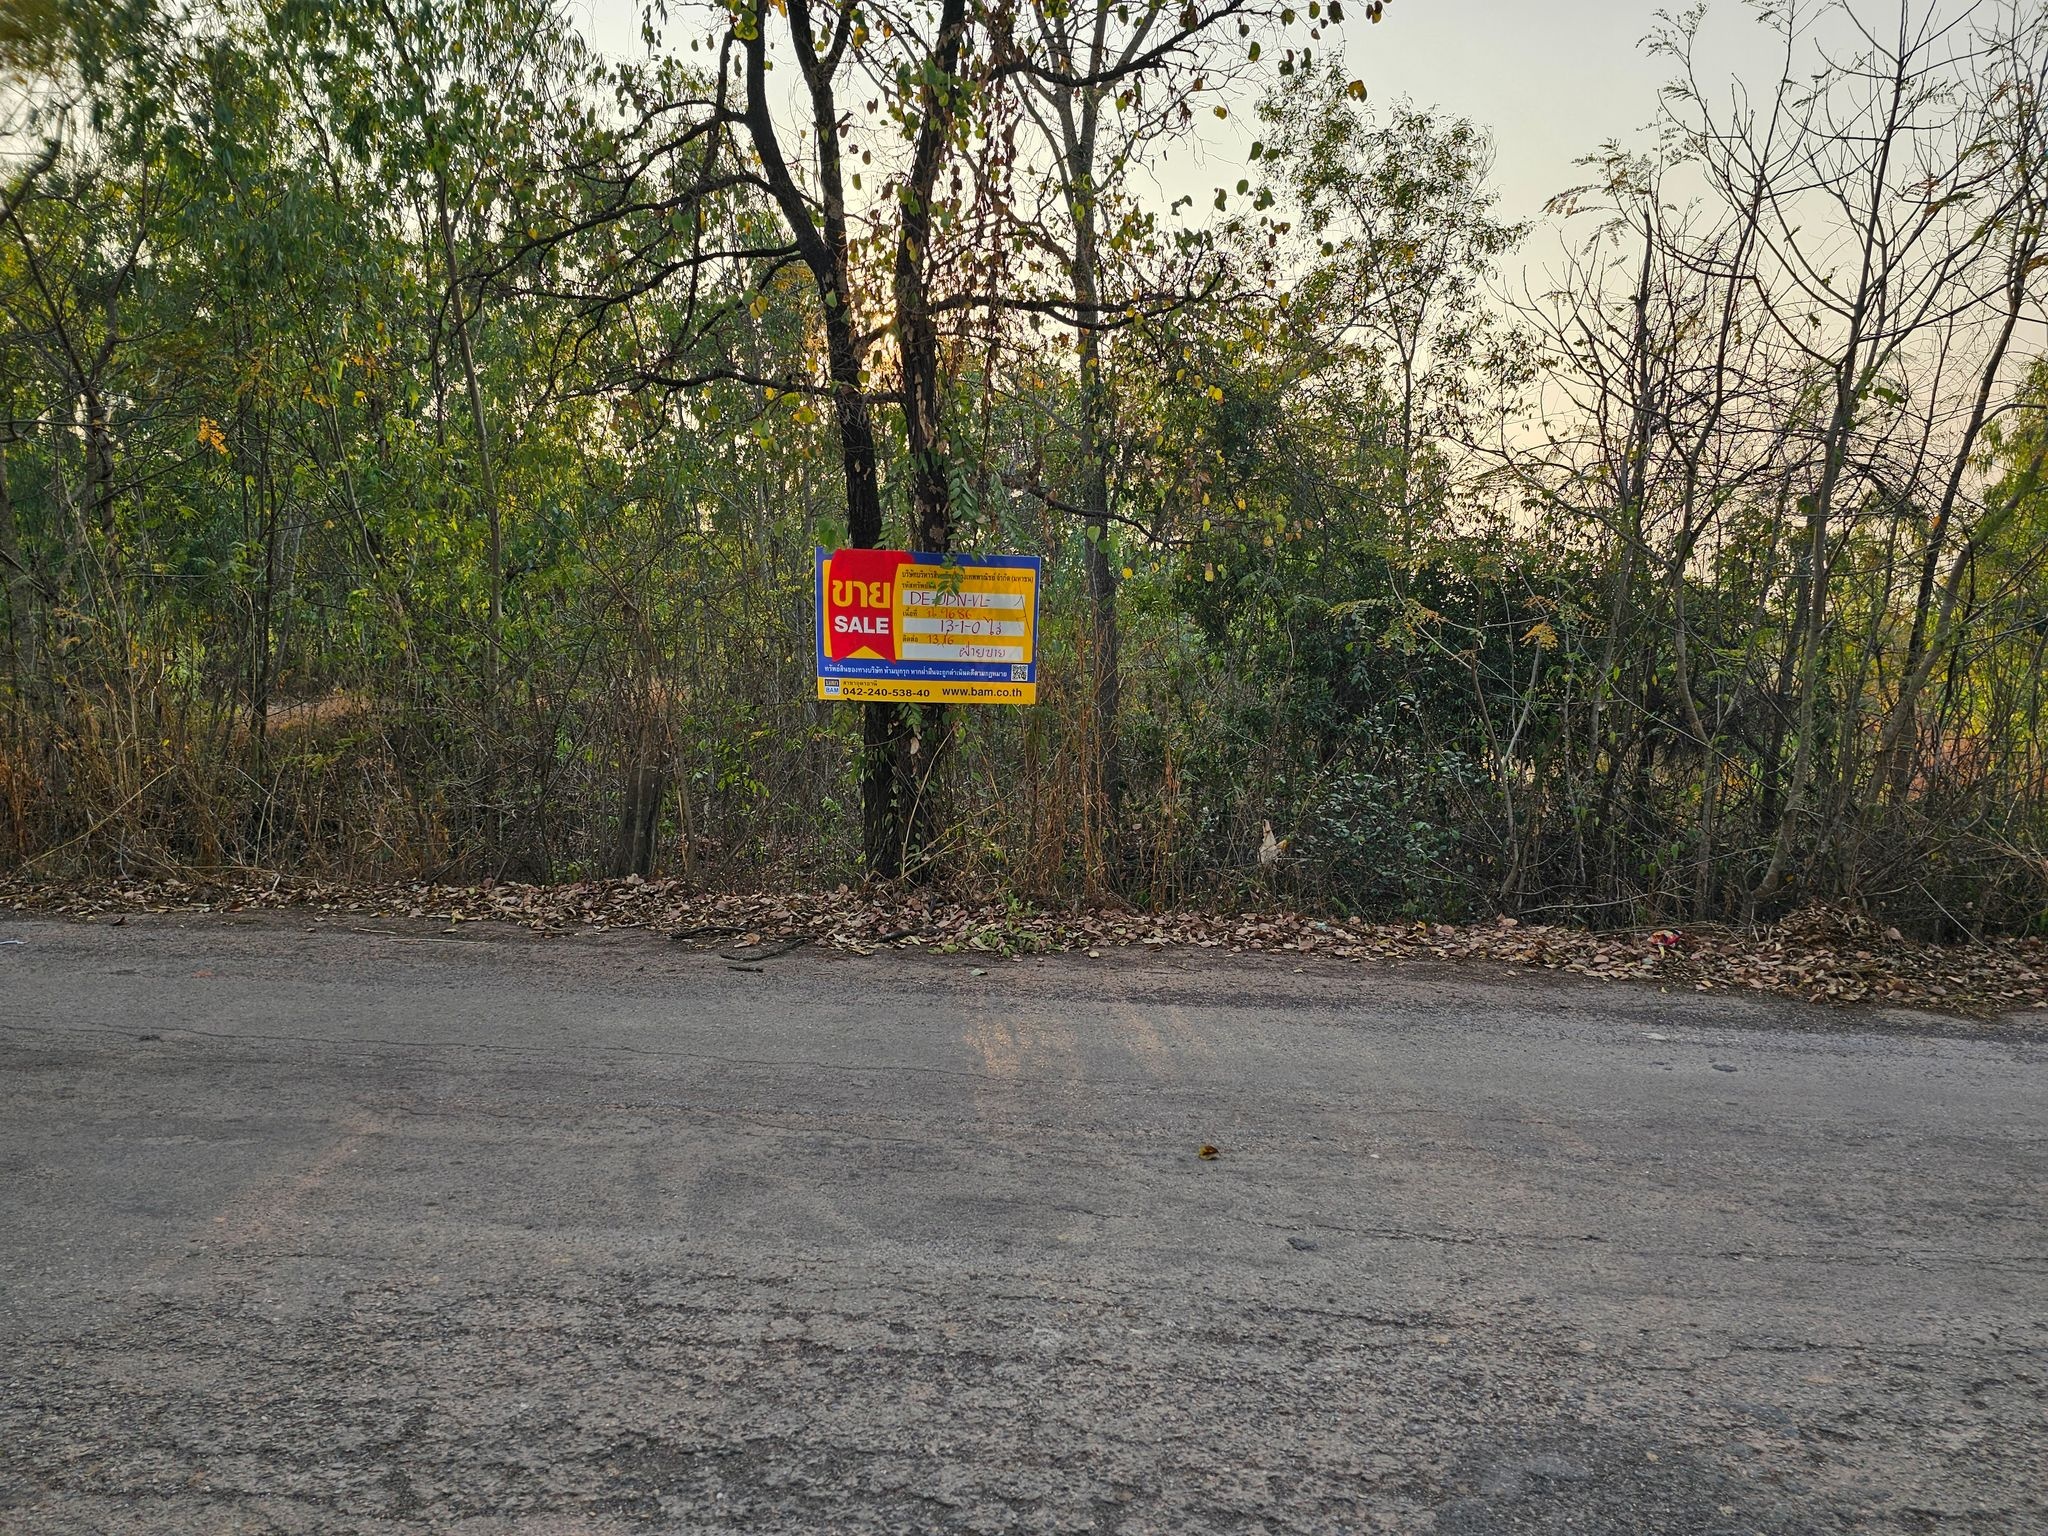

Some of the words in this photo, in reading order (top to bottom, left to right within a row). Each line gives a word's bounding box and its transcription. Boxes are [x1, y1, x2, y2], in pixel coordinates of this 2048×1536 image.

[832, 580, 891, 609] ขาย
[834, 615, 889, 634] SALE
[842, 687, 930, 697] 042-240-538-40
[942, 687, 1022, 697] www.bam.co.th
